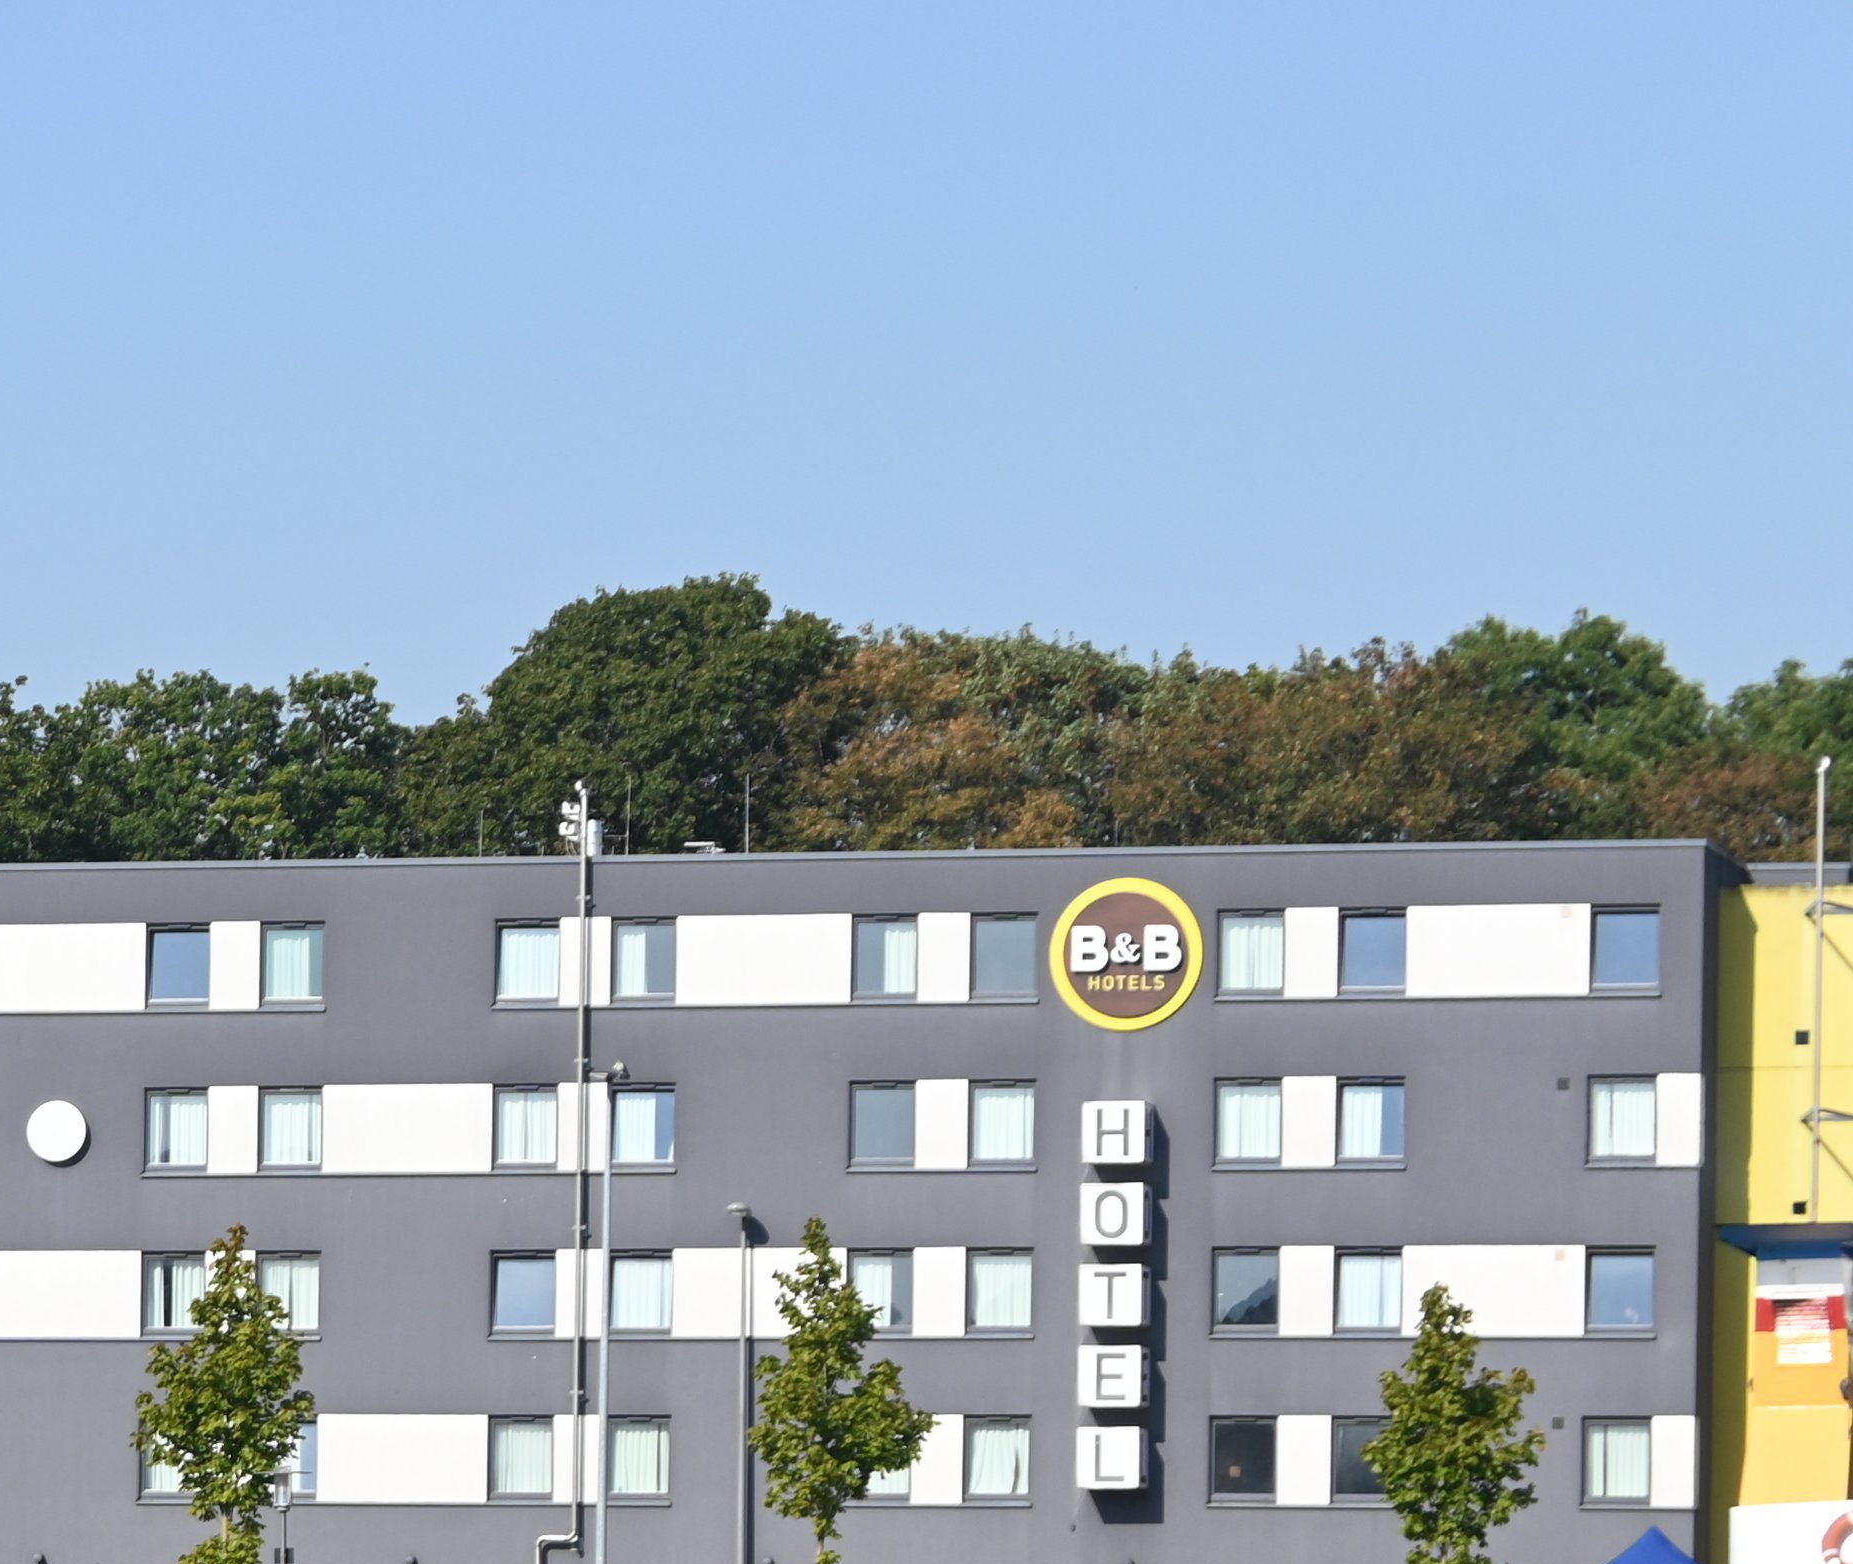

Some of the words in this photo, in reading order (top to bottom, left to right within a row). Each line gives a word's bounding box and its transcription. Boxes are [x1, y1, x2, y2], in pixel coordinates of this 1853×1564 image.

[1070, 924, 1182, 973] B&B
[1086, 974, 1166, 992] HOTELS
[1094, 1107, 1131, 1483] HOTEL
